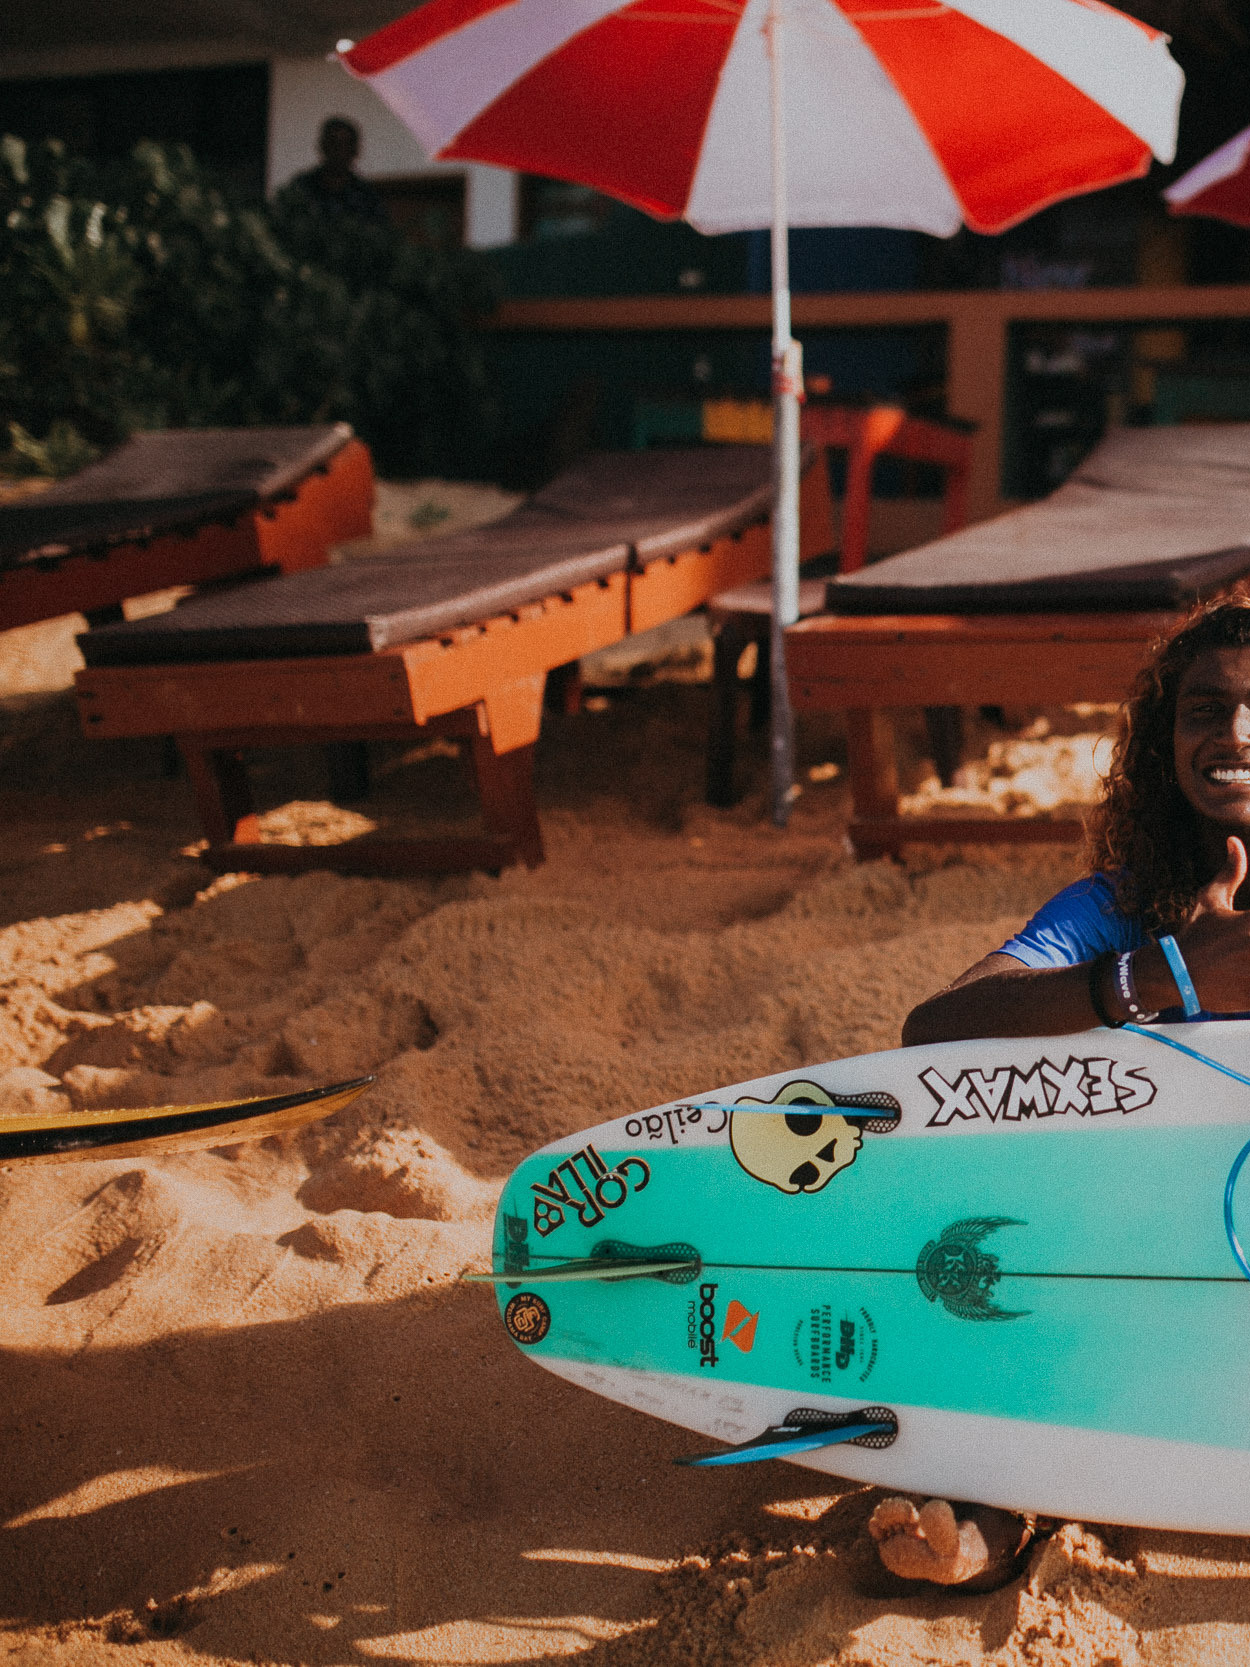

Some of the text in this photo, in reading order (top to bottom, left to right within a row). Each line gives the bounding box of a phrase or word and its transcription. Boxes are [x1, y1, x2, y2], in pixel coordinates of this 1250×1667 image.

[625, 1101, 728, 1144] Ceilão
[917, 1054, 1158, 1127] SEXWAX
[687, 1300, 697, 1349] mobile
[700, 1283, 719, 1368] boost
[810, 1308, 820, 1379] SURFBOARDS
[821, 1304, 832, 1384] PERFORMANCE
[835, 1319, 855, 1369] DHD
